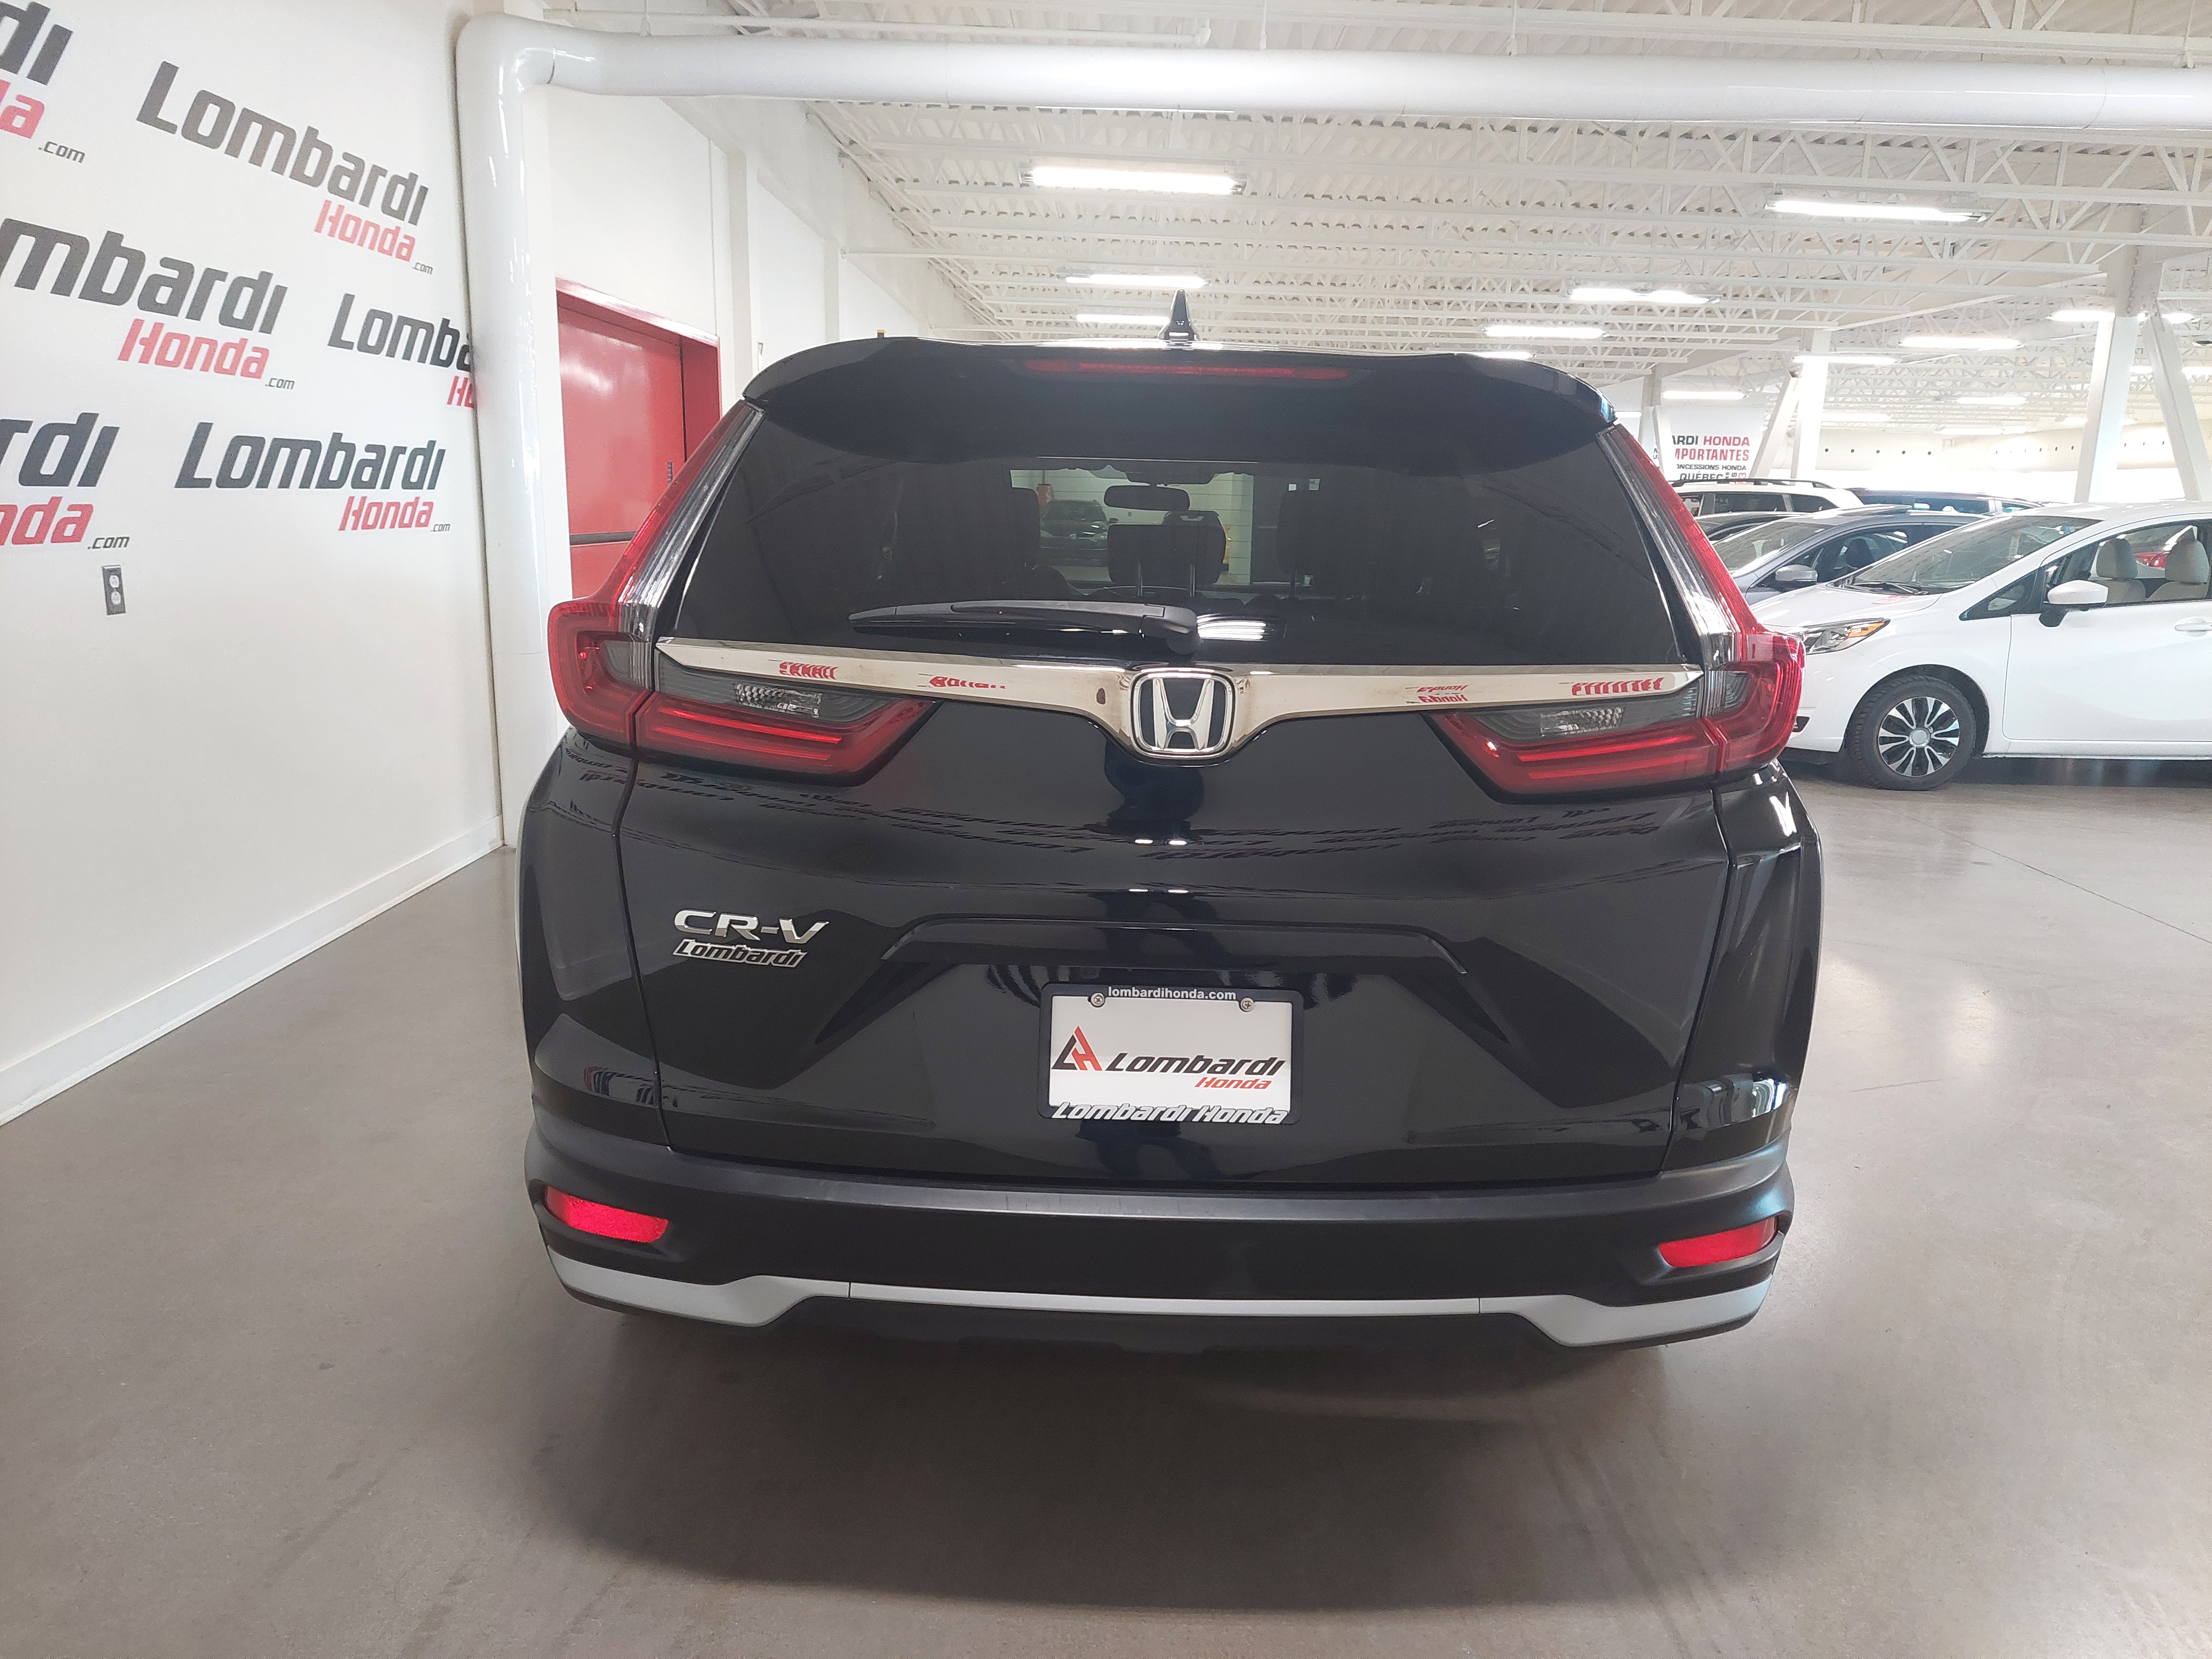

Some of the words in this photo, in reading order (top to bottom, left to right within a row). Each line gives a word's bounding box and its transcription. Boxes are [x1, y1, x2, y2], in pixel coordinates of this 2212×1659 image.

[0, 79, 44, 139] a
[38, 141, 85, 163] .com
[136, 61, 429, 226] Lombardi
[314, 199, 415, 262] Honda
[412, 262, 433, 275] .com
[0, 218, 288, 334] mbardi
[118, 319, 269, 379] Honda
[265, 378, 295, 390] .com
[174, 422, 446, 489] Lombardi
[1703, 436, 1750, 446] HONDA
[339, 496, 434, 531] Honda
[431, 523, 451, 532] .com
[87, 536, 130, 550] .com
[674, 909, 830, 944] CR-V
[673, 939, 807, 968] Lombardi
[1108, 986, 1237, 1001] lombardihonda.com
[1105, 1052, 1287, 1076] Lombardi
[1194, 1077, 1272, 1089] Honda
[1051, 1101, 1192, 1122] Lombardi
[1192, 1105, 1289, 1125] Honda
